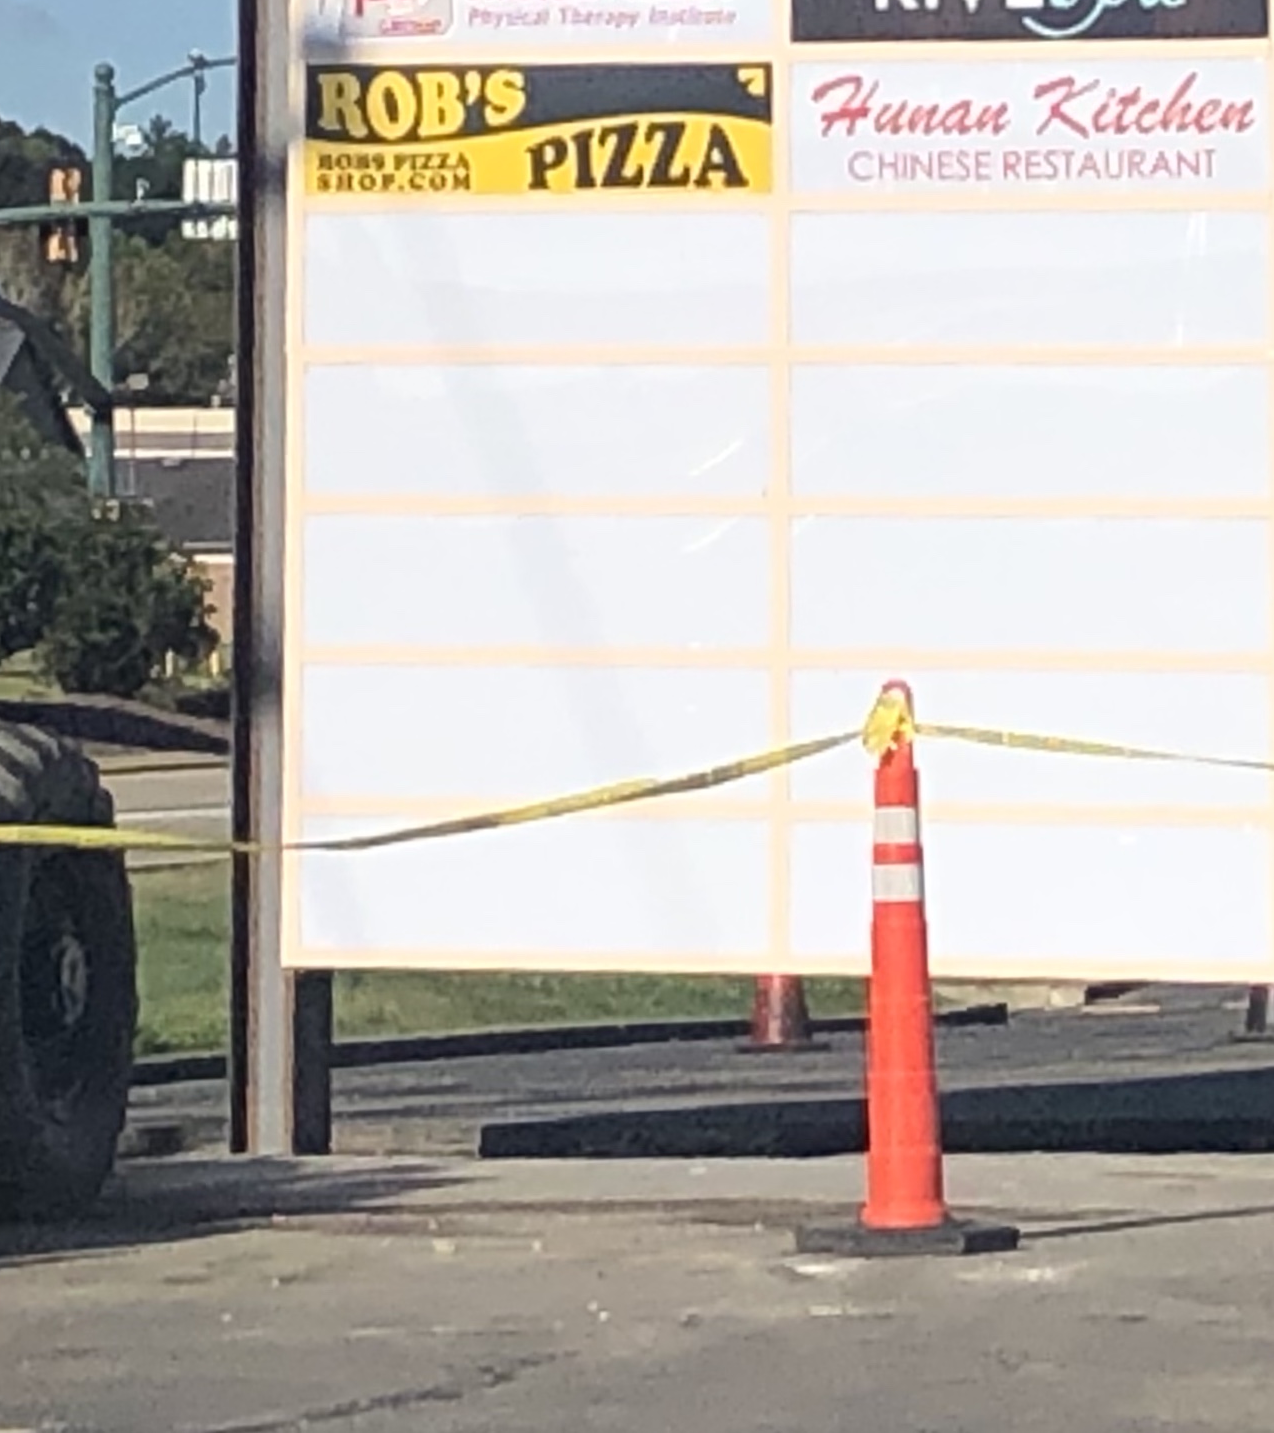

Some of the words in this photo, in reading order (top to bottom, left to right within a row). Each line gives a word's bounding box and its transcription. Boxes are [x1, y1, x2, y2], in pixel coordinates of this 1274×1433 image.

[468, 7, 550, 28] Physical
[559, 7, 639, 28] Therapy
[318, 69, 526, 140] ROB'S
[811, 74, 1010, 138] Hunan
[1034, 71, 1255, 139] Kitchen
[393, 152, 471, 170] PIZZA
[526, 121, 750, 191] PIZZA
[847, 150, 992, 183] CHINESE
[1003, 148, 1217, 182] RESTAURANT
[317, 172, 471, 192] SHOP.COM
